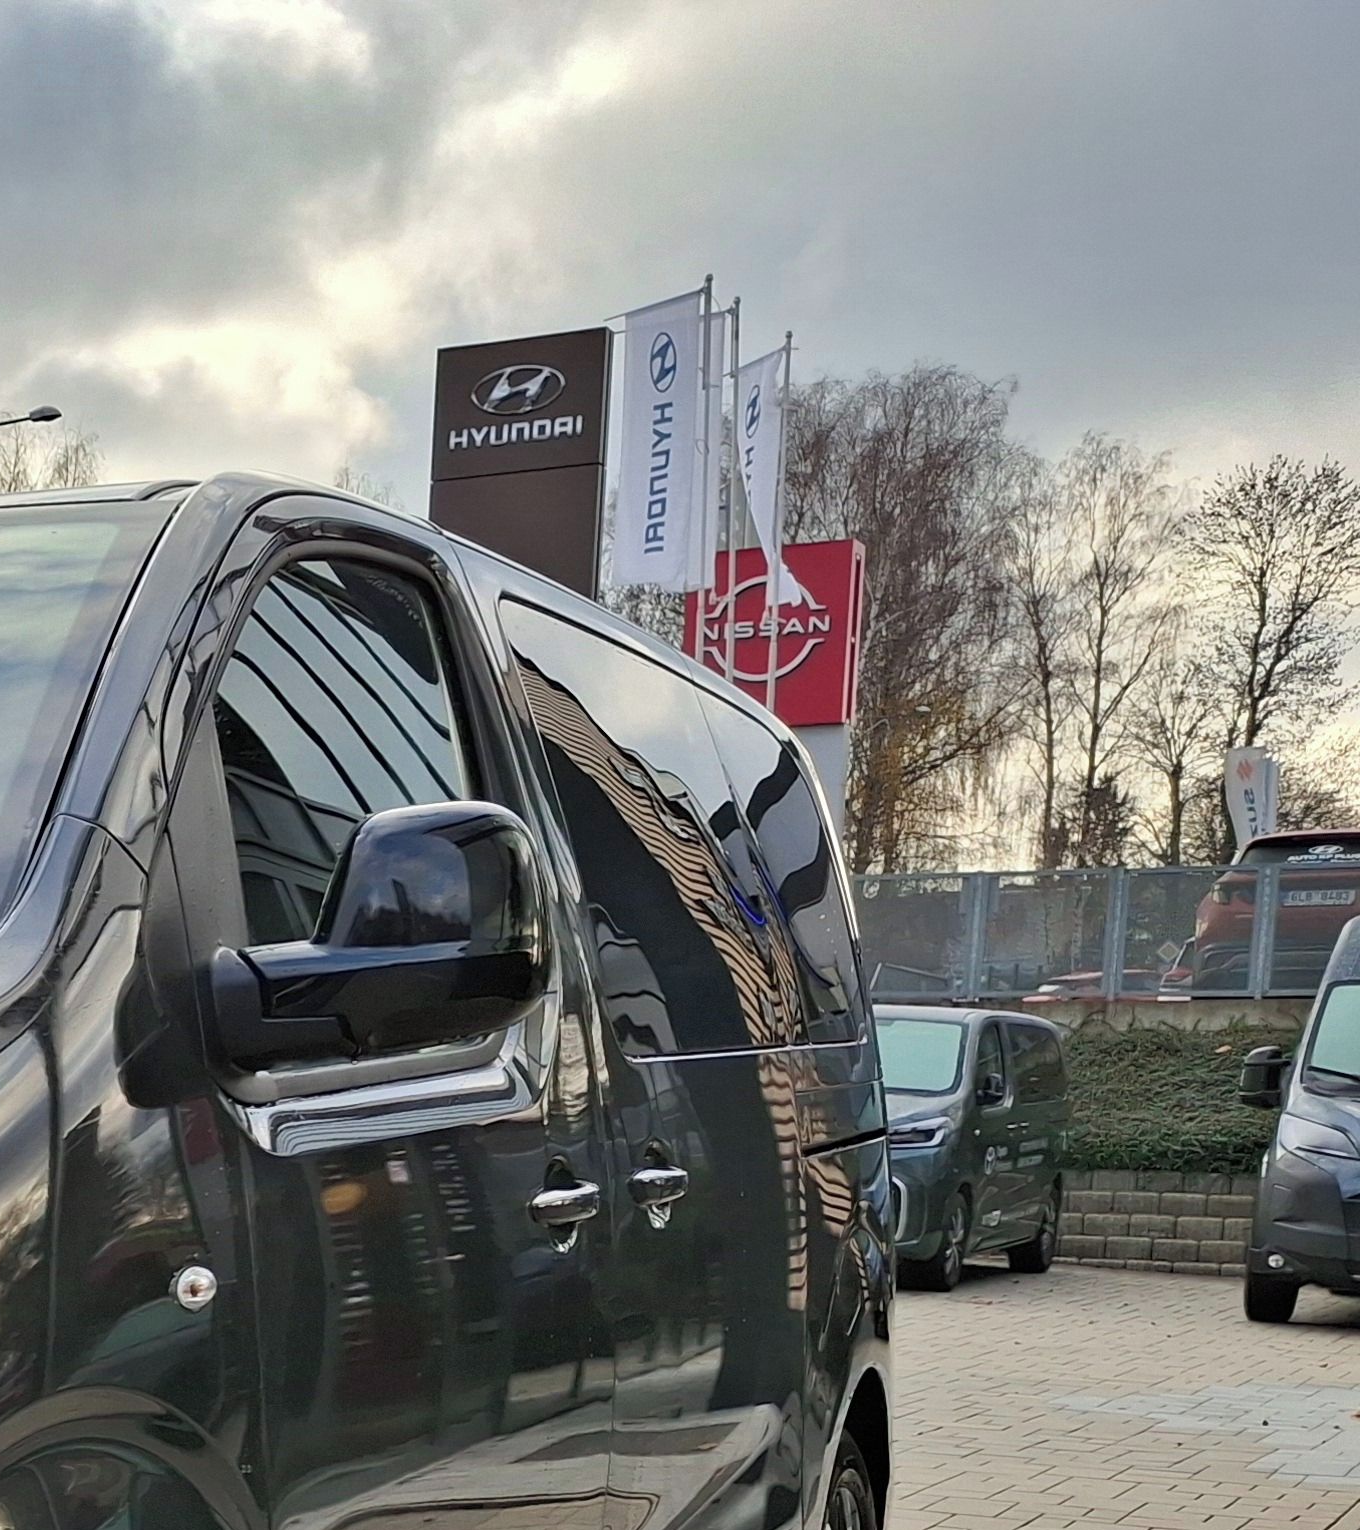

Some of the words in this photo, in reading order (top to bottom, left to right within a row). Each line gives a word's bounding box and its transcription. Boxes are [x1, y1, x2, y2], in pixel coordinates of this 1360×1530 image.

[448, 415, 584, 450] HYUNDAI
[644, 402, 673, 555] HYUNDAI
[703, 614, 831, 641] NISSAN
